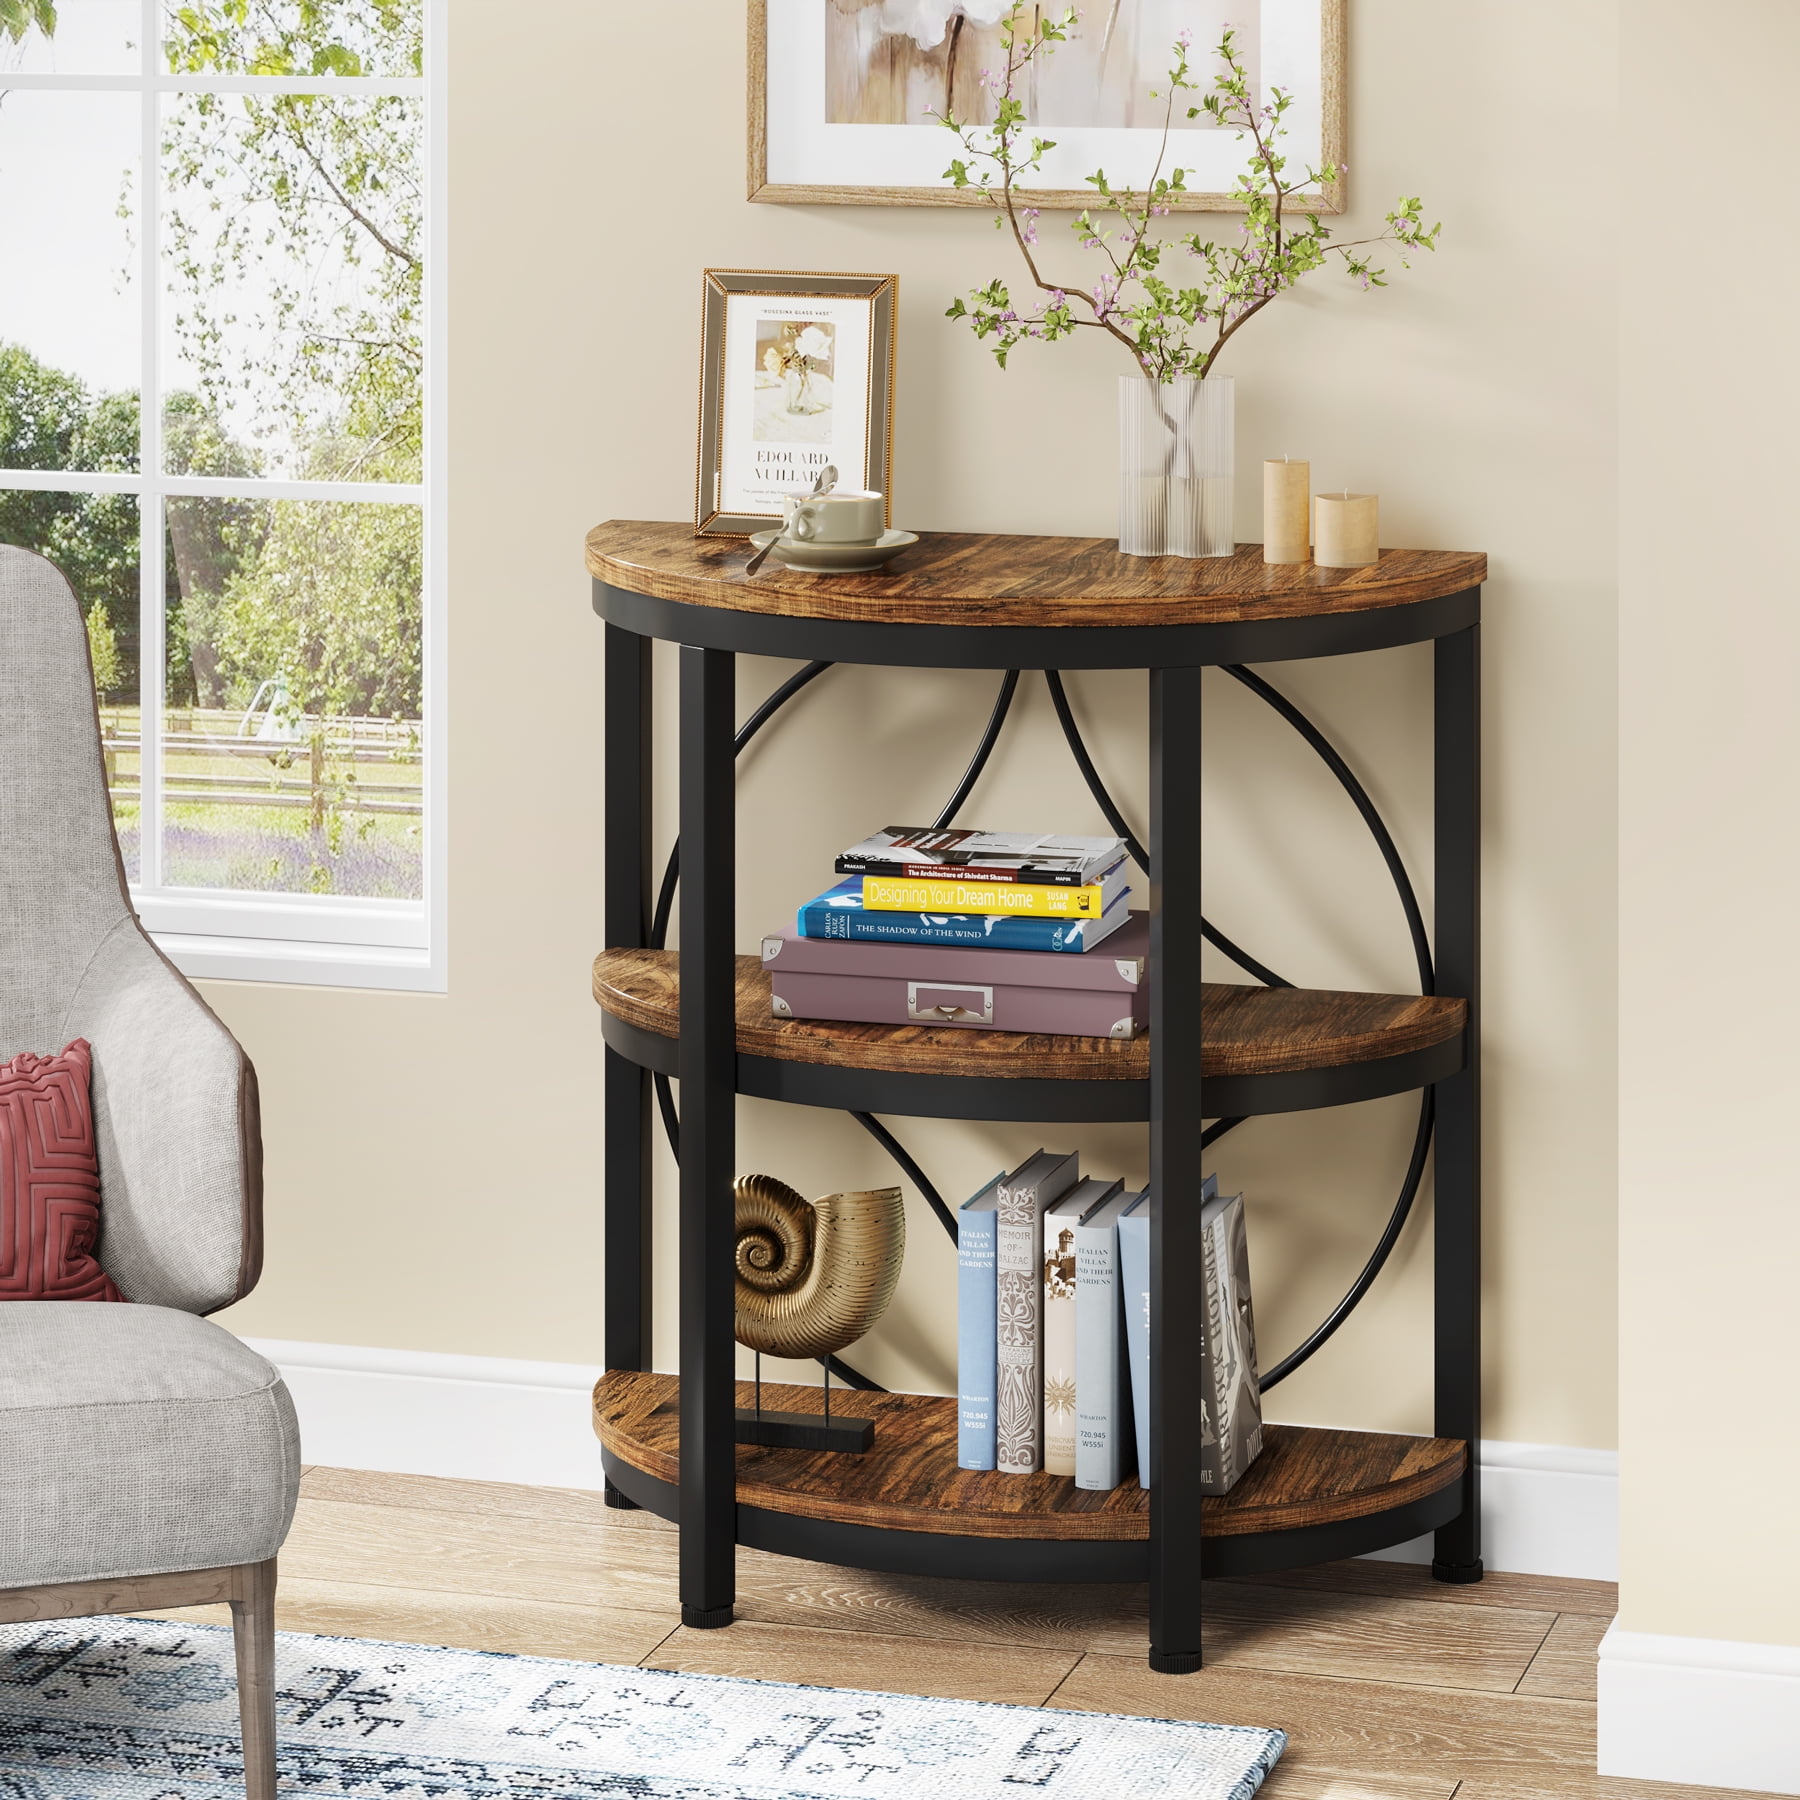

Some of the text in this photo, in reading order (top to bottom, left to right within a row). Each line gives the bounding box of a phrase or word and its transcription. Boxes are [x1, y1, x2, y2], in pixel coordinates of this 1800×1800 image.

[755, 468, 818, 482] VUILLAR
[920, 869, 956, 878] Architecture
[957, 871, 963, 879] of
[869, 882, 1034, 908] Designing Your Dream Home
[1046, 891, 1069, 901] SUSAN
[1048, 901, 1067, 910] LANG
[856, 924, 982, 939] THE SHADOW OF THE WIND
[960, 1230, 991, 1239] ITALIAN
[962, 1240, 989, 1248] VILLAS
[1078, 1247, 1109, 1255] ITALIAN
[959, 1259, 993, 1268] GARDENS
[1080, 1257, 1107, 1265] VILLAS
[1076, 1277, 1111, 1285] GARDENS
[962, 1410, 988, 1420] 720.945
[1080, 1430, 1106, 1439] 720.945
